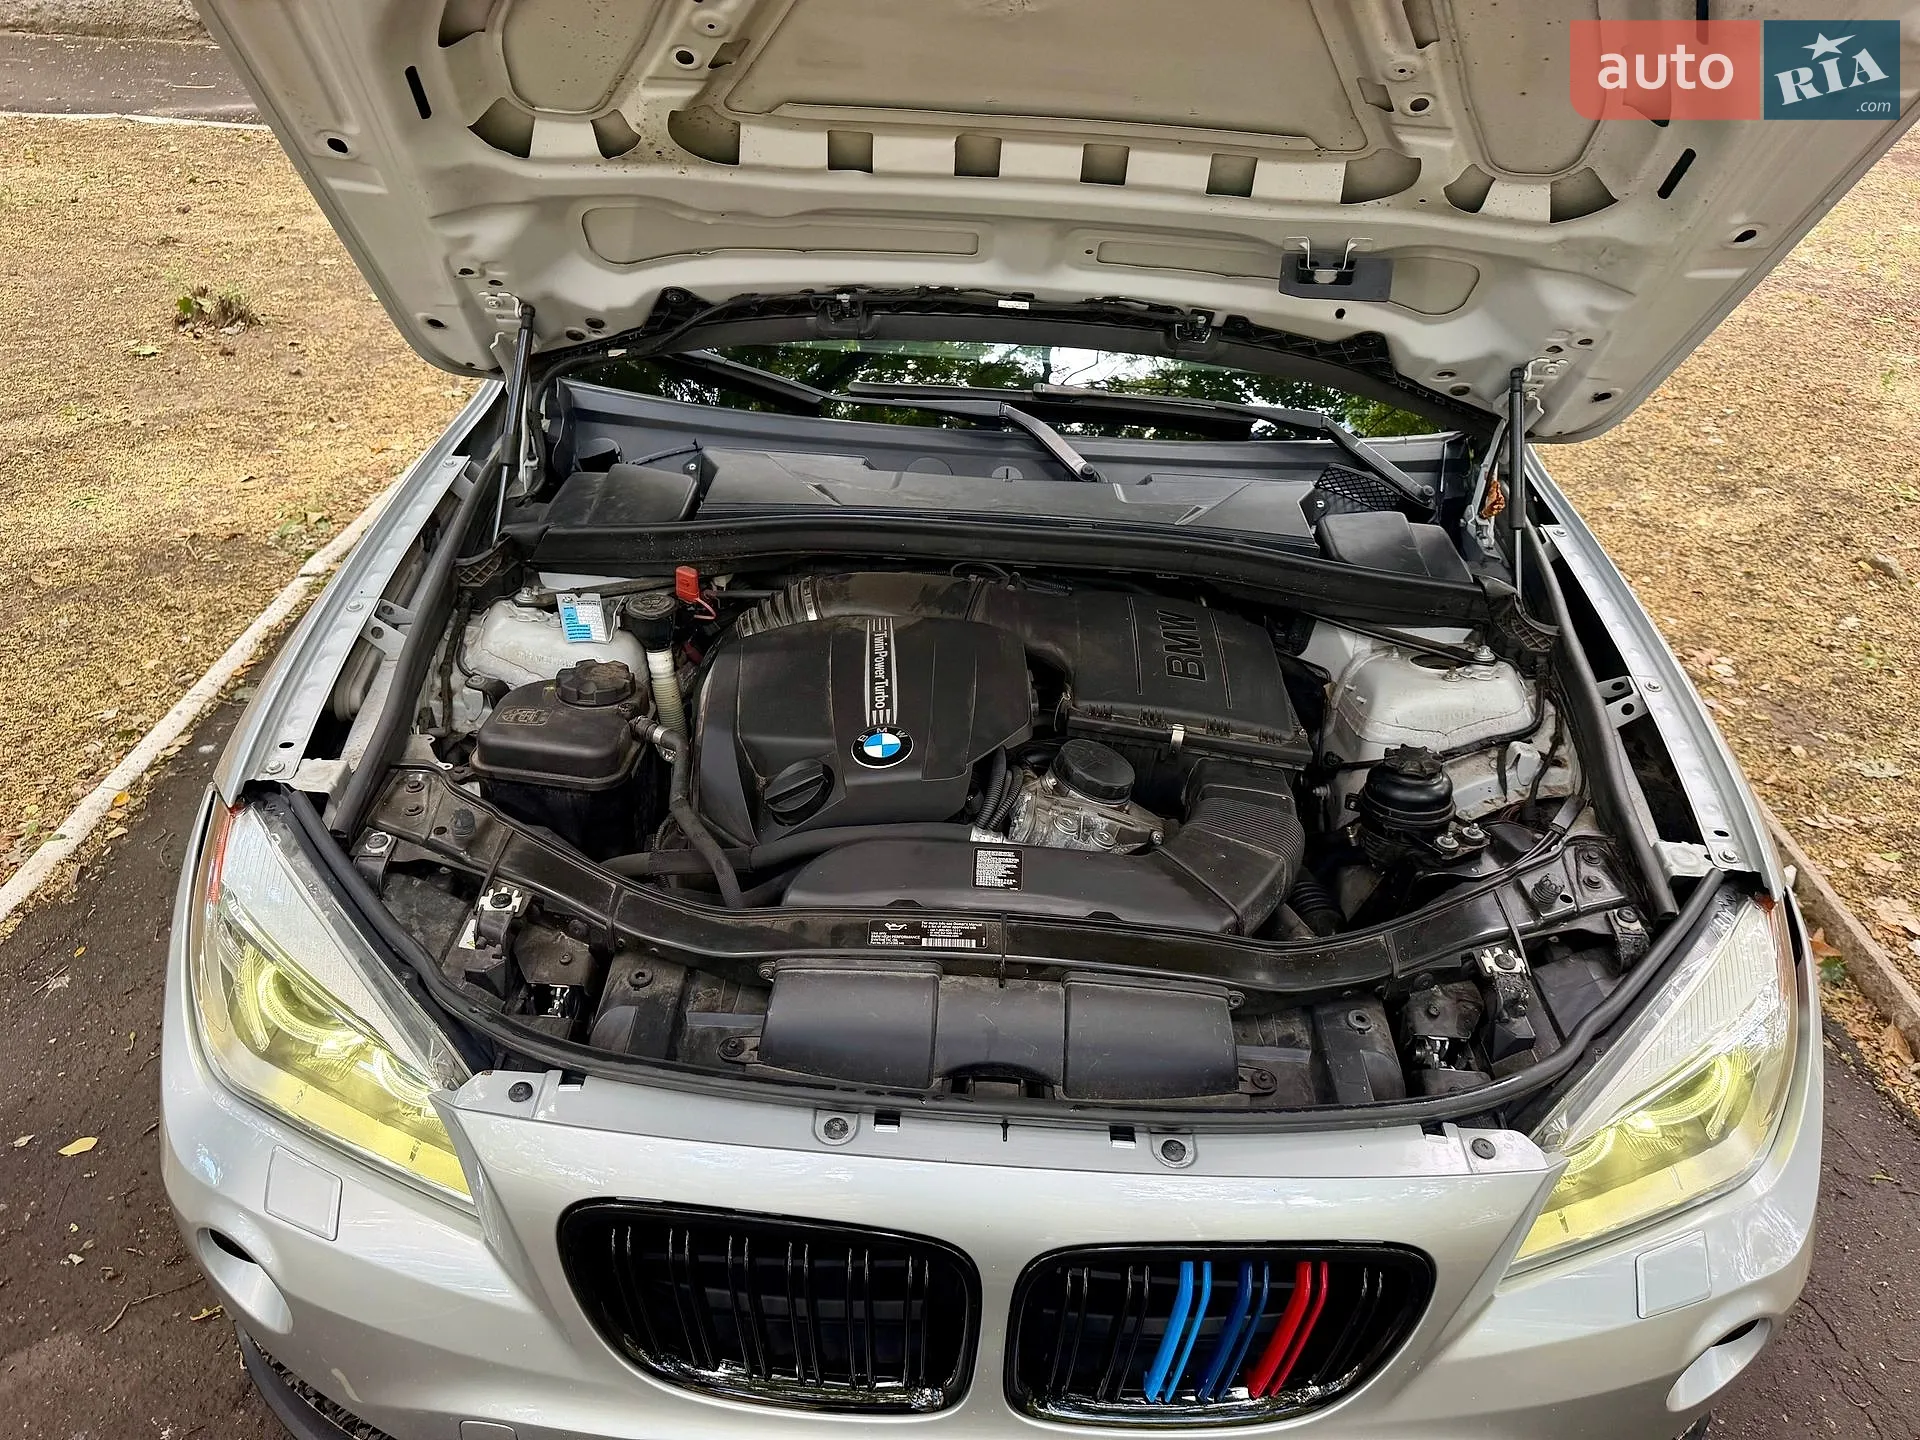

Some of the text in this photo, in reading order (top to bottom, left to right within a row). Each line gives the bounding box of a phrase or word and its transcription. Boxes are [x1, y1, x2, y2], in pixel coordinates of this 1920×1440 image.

[874, 631, 889, 709] TwinPower Turbo
[1157, 609, 1207, 682] BMW
